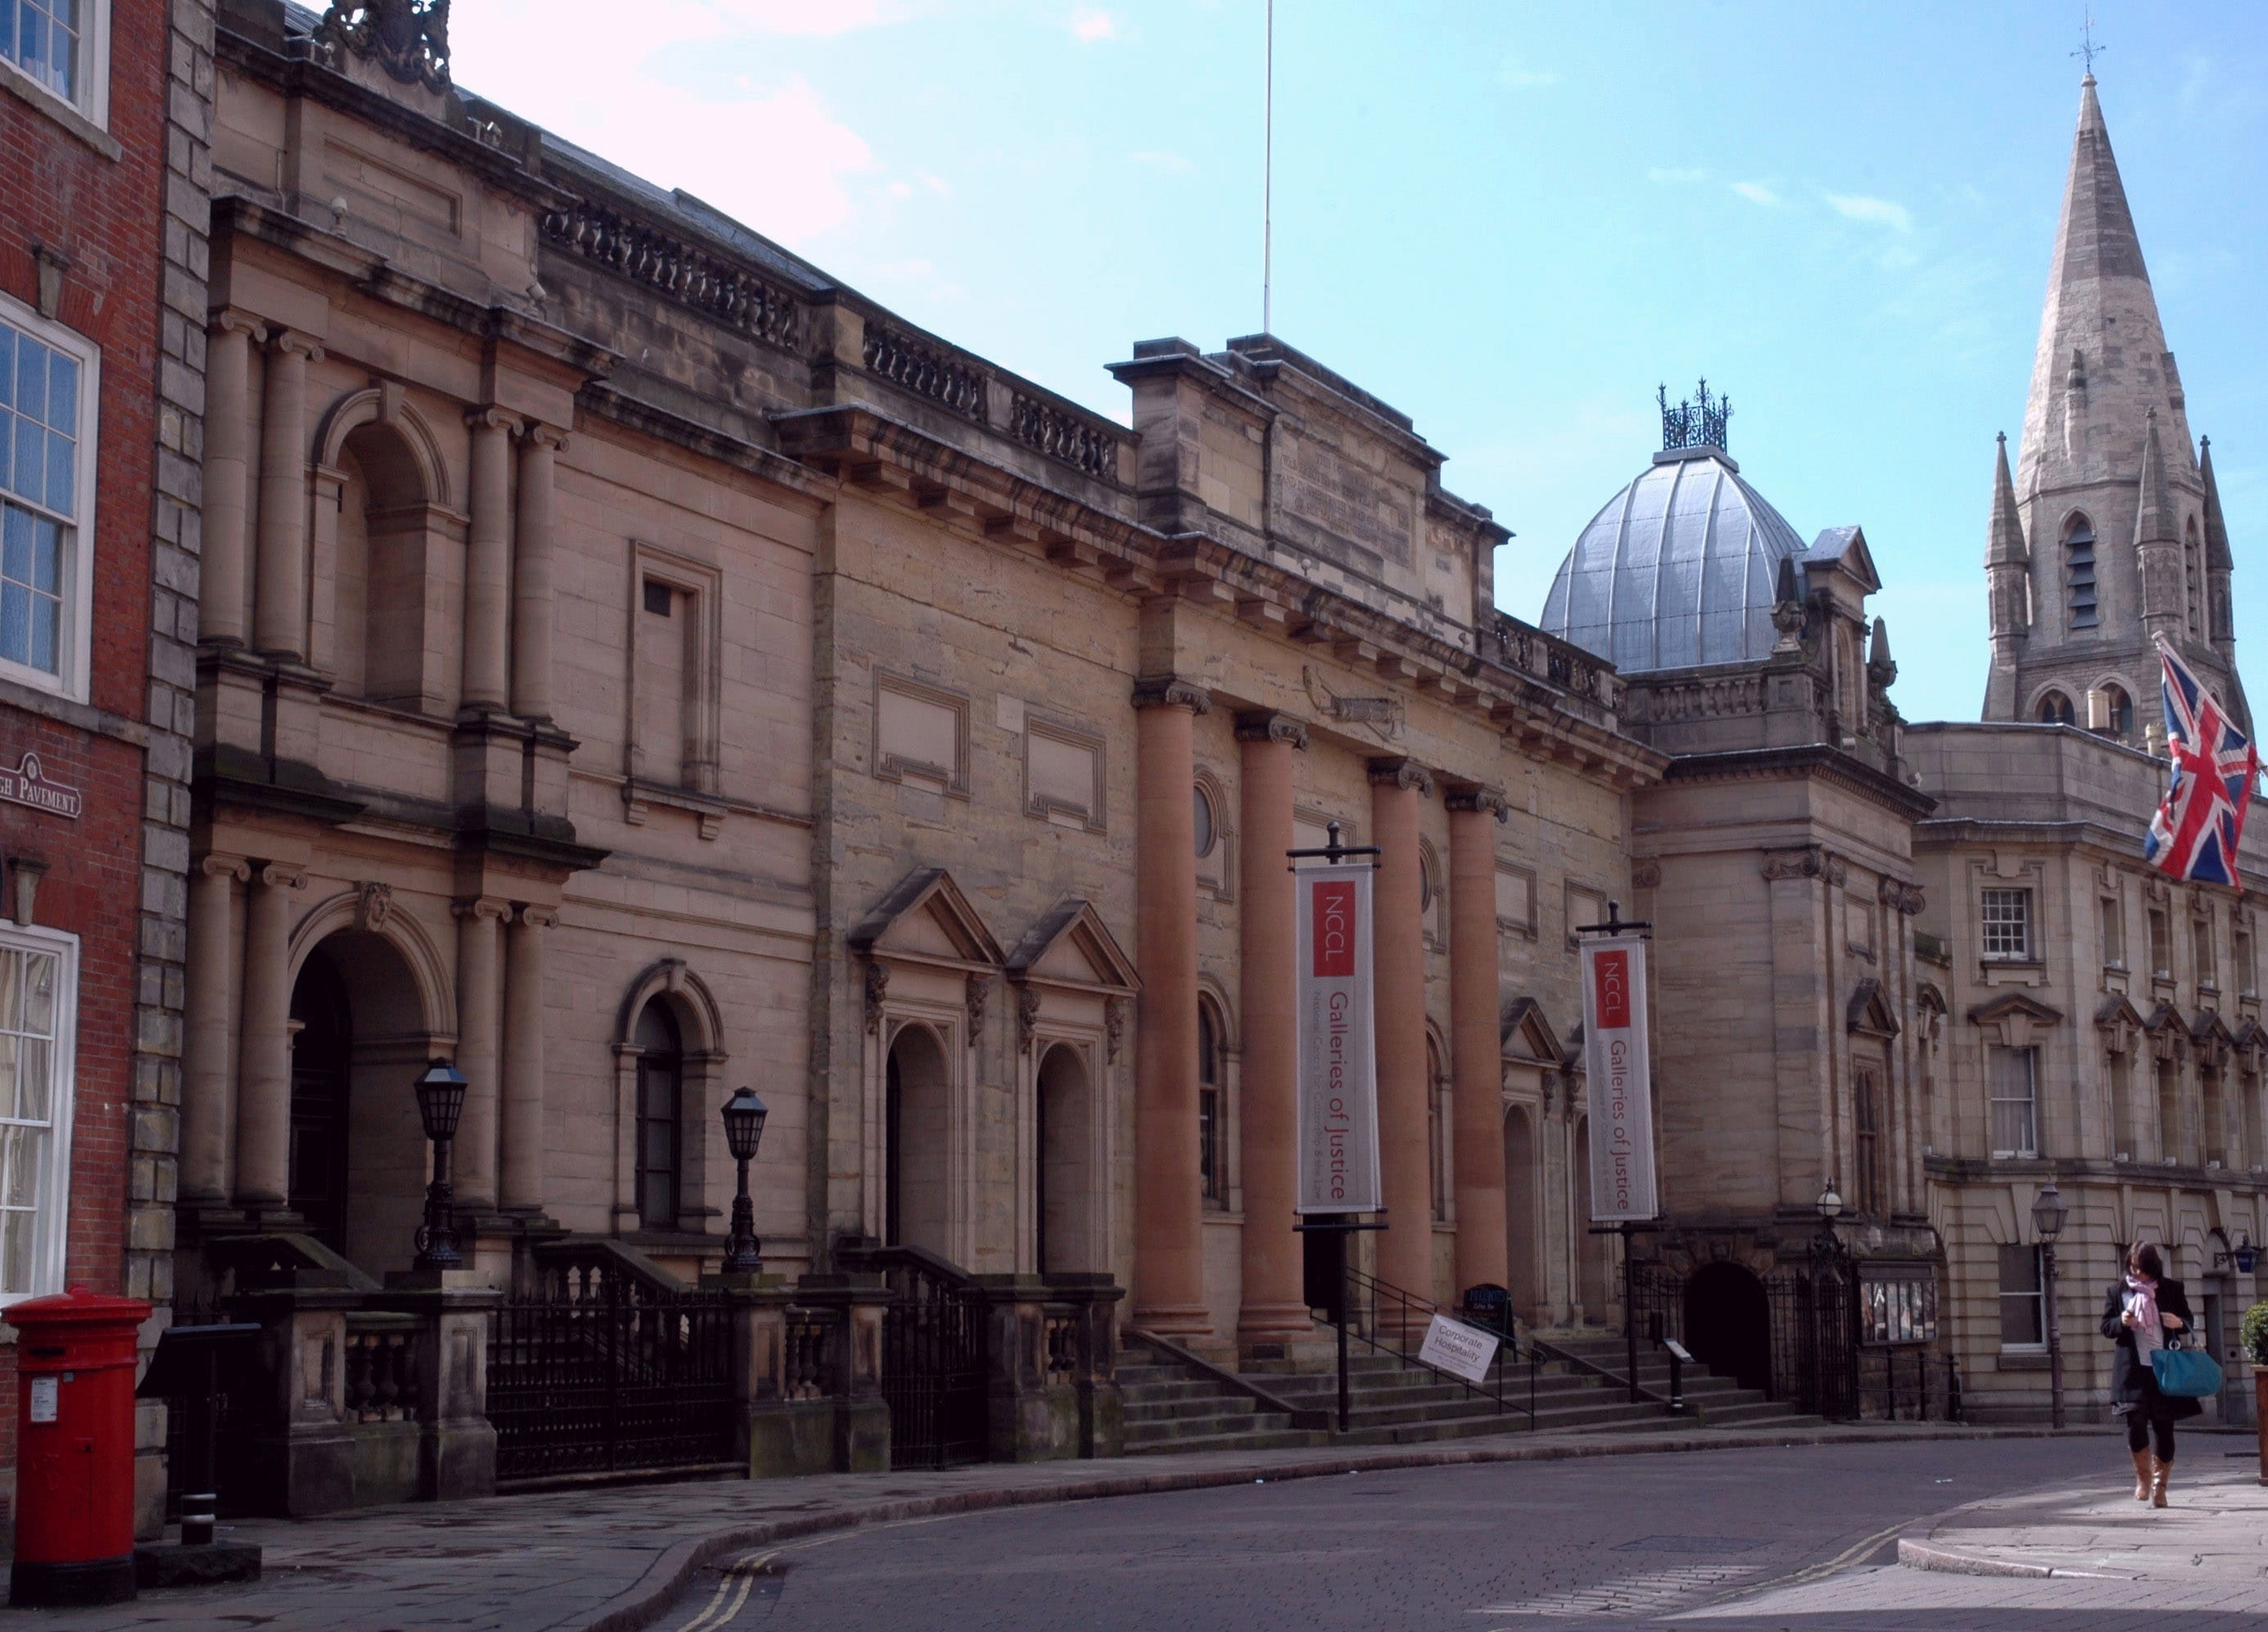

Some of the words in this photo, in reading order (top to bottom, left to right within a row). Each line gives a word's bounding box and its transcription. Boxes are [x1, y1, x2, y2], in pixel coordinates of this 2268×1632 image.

[19, 776, 76, 812] PAVEMENT
[1325, 896, 1344, 961] NCCL
[1605, 962, 1621, 1016] NCCL
[1329, 991, 1349, 1089] Galleries
[1610, 1039, 1627, 1120] Galleries
[1329, 1098, 1349, 1121] of
[1614, 1127, 1631, 1146] of
[1324, 1126, 1350, 1200] Justice
[1609, 1149, 1632, 1210] Justice
[1434, 1336, 1481, 1363] Hospitality
[1439, 1326, 1482, 1349] Corporate
